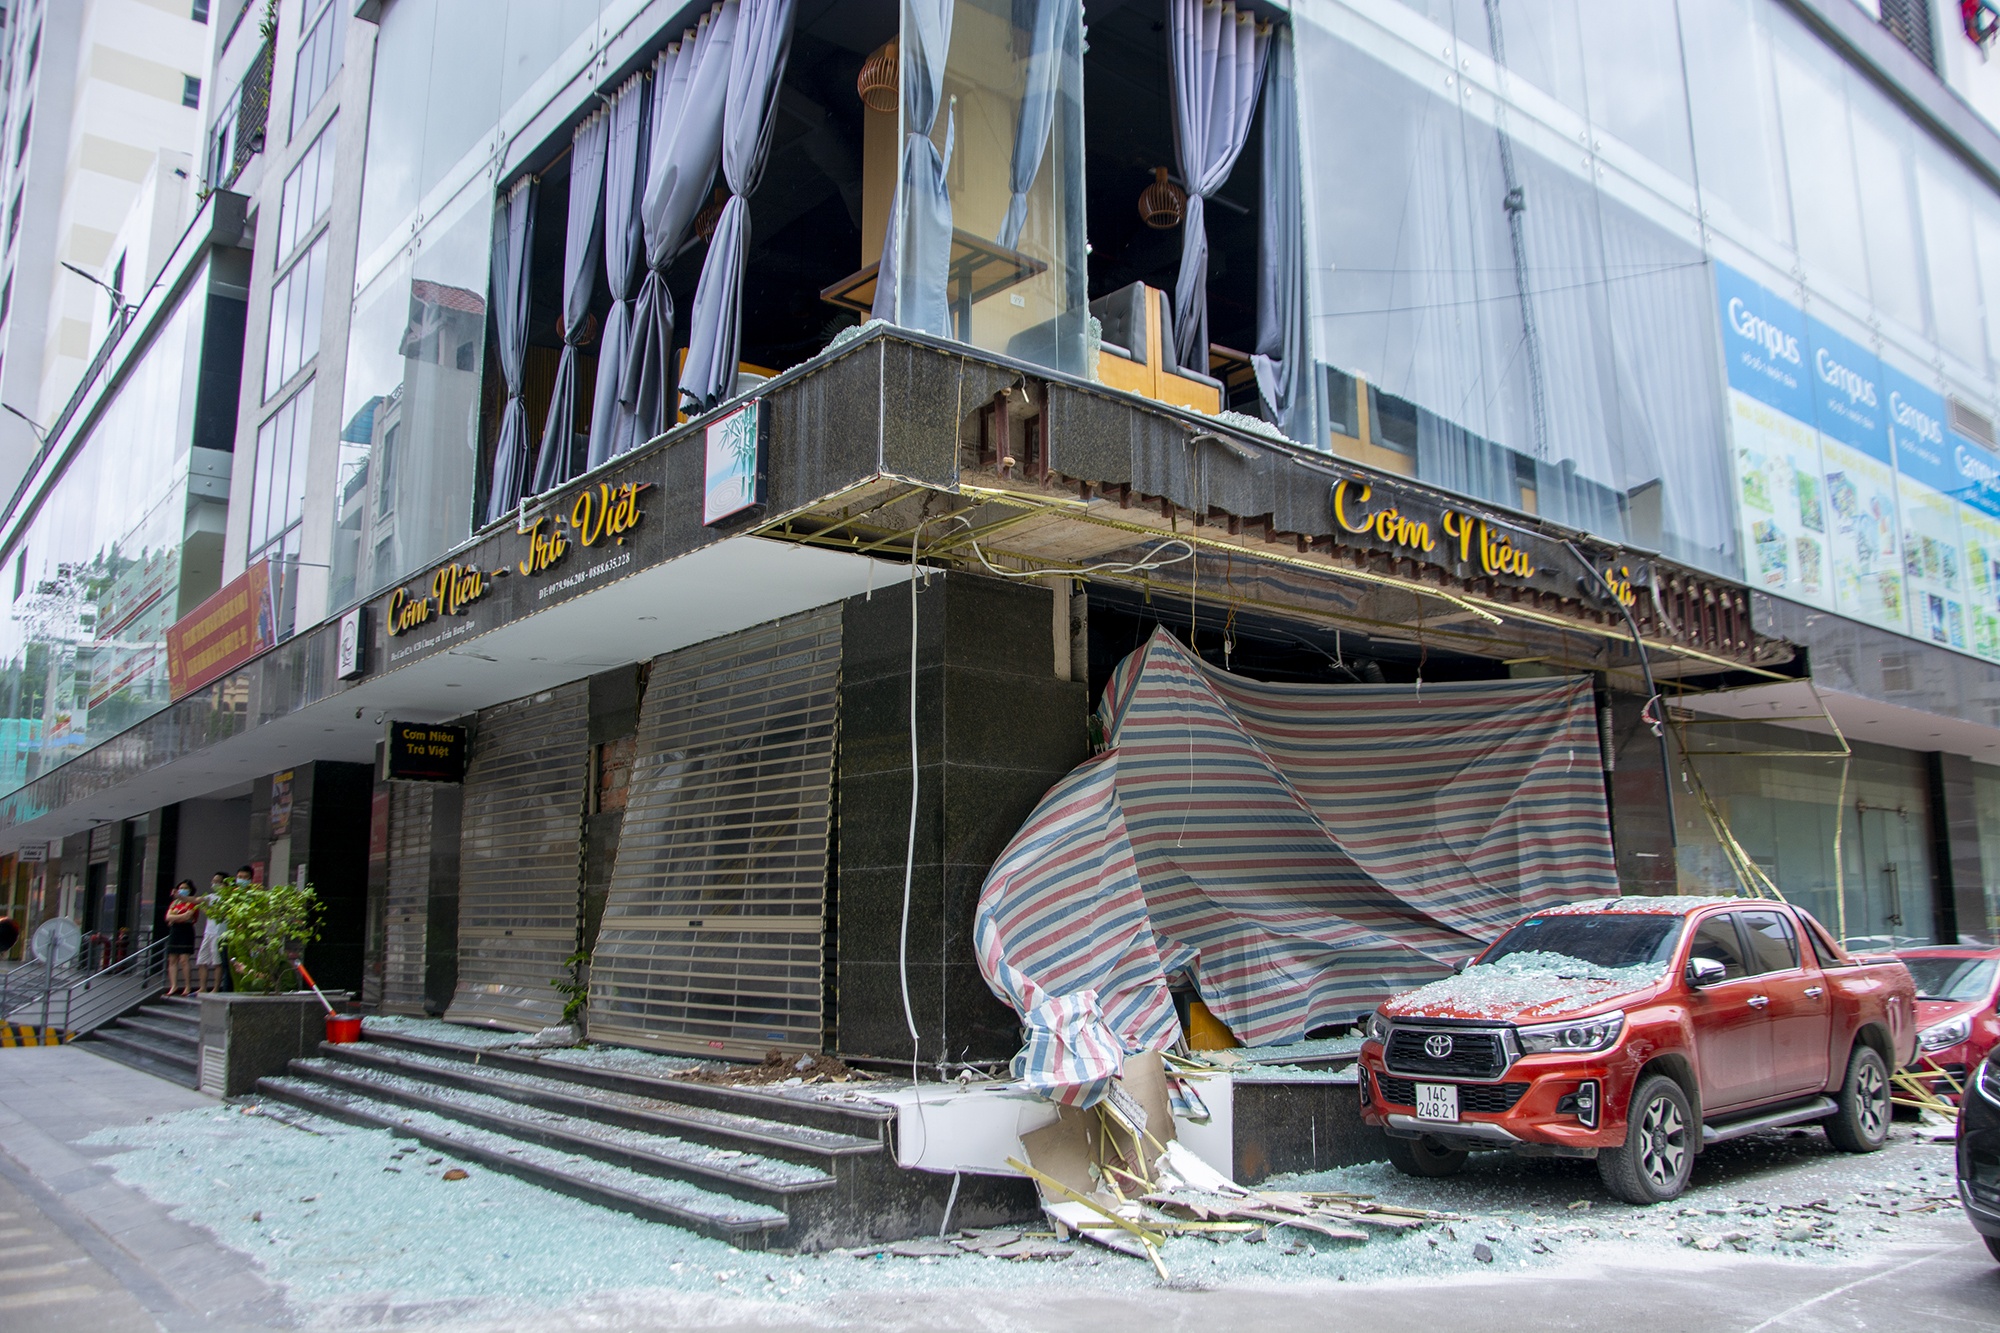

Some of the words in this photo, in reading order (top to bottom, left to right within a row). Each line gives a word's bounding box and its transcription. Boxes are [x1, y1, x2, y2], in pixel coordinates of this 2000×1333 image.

[1727, 296, 1800, 365] Campus
[1815, 347, 1877, 408] Campus
[1889, 390, 1943, 444] Campus
[1331, 478, 1436, 553] Cơm
[1441, 508, 1535, 579] Niêu
[387, 587, 430, 636] Cơm
[432, 562, 485, 616] Niêu
[517, 514, 568, 577] Trà
[571, 481, 653, 547] Việt
[402, 728, 426, 740] Cơm
[429, 730, 455, 743] Niêu
[406, 743, 426, 755] Trà
[427, 744, 449, 758] Việt
[1418, 1101, 1456, 1119] 248.21
[1426, 1086, 1447, 1102] 14C
